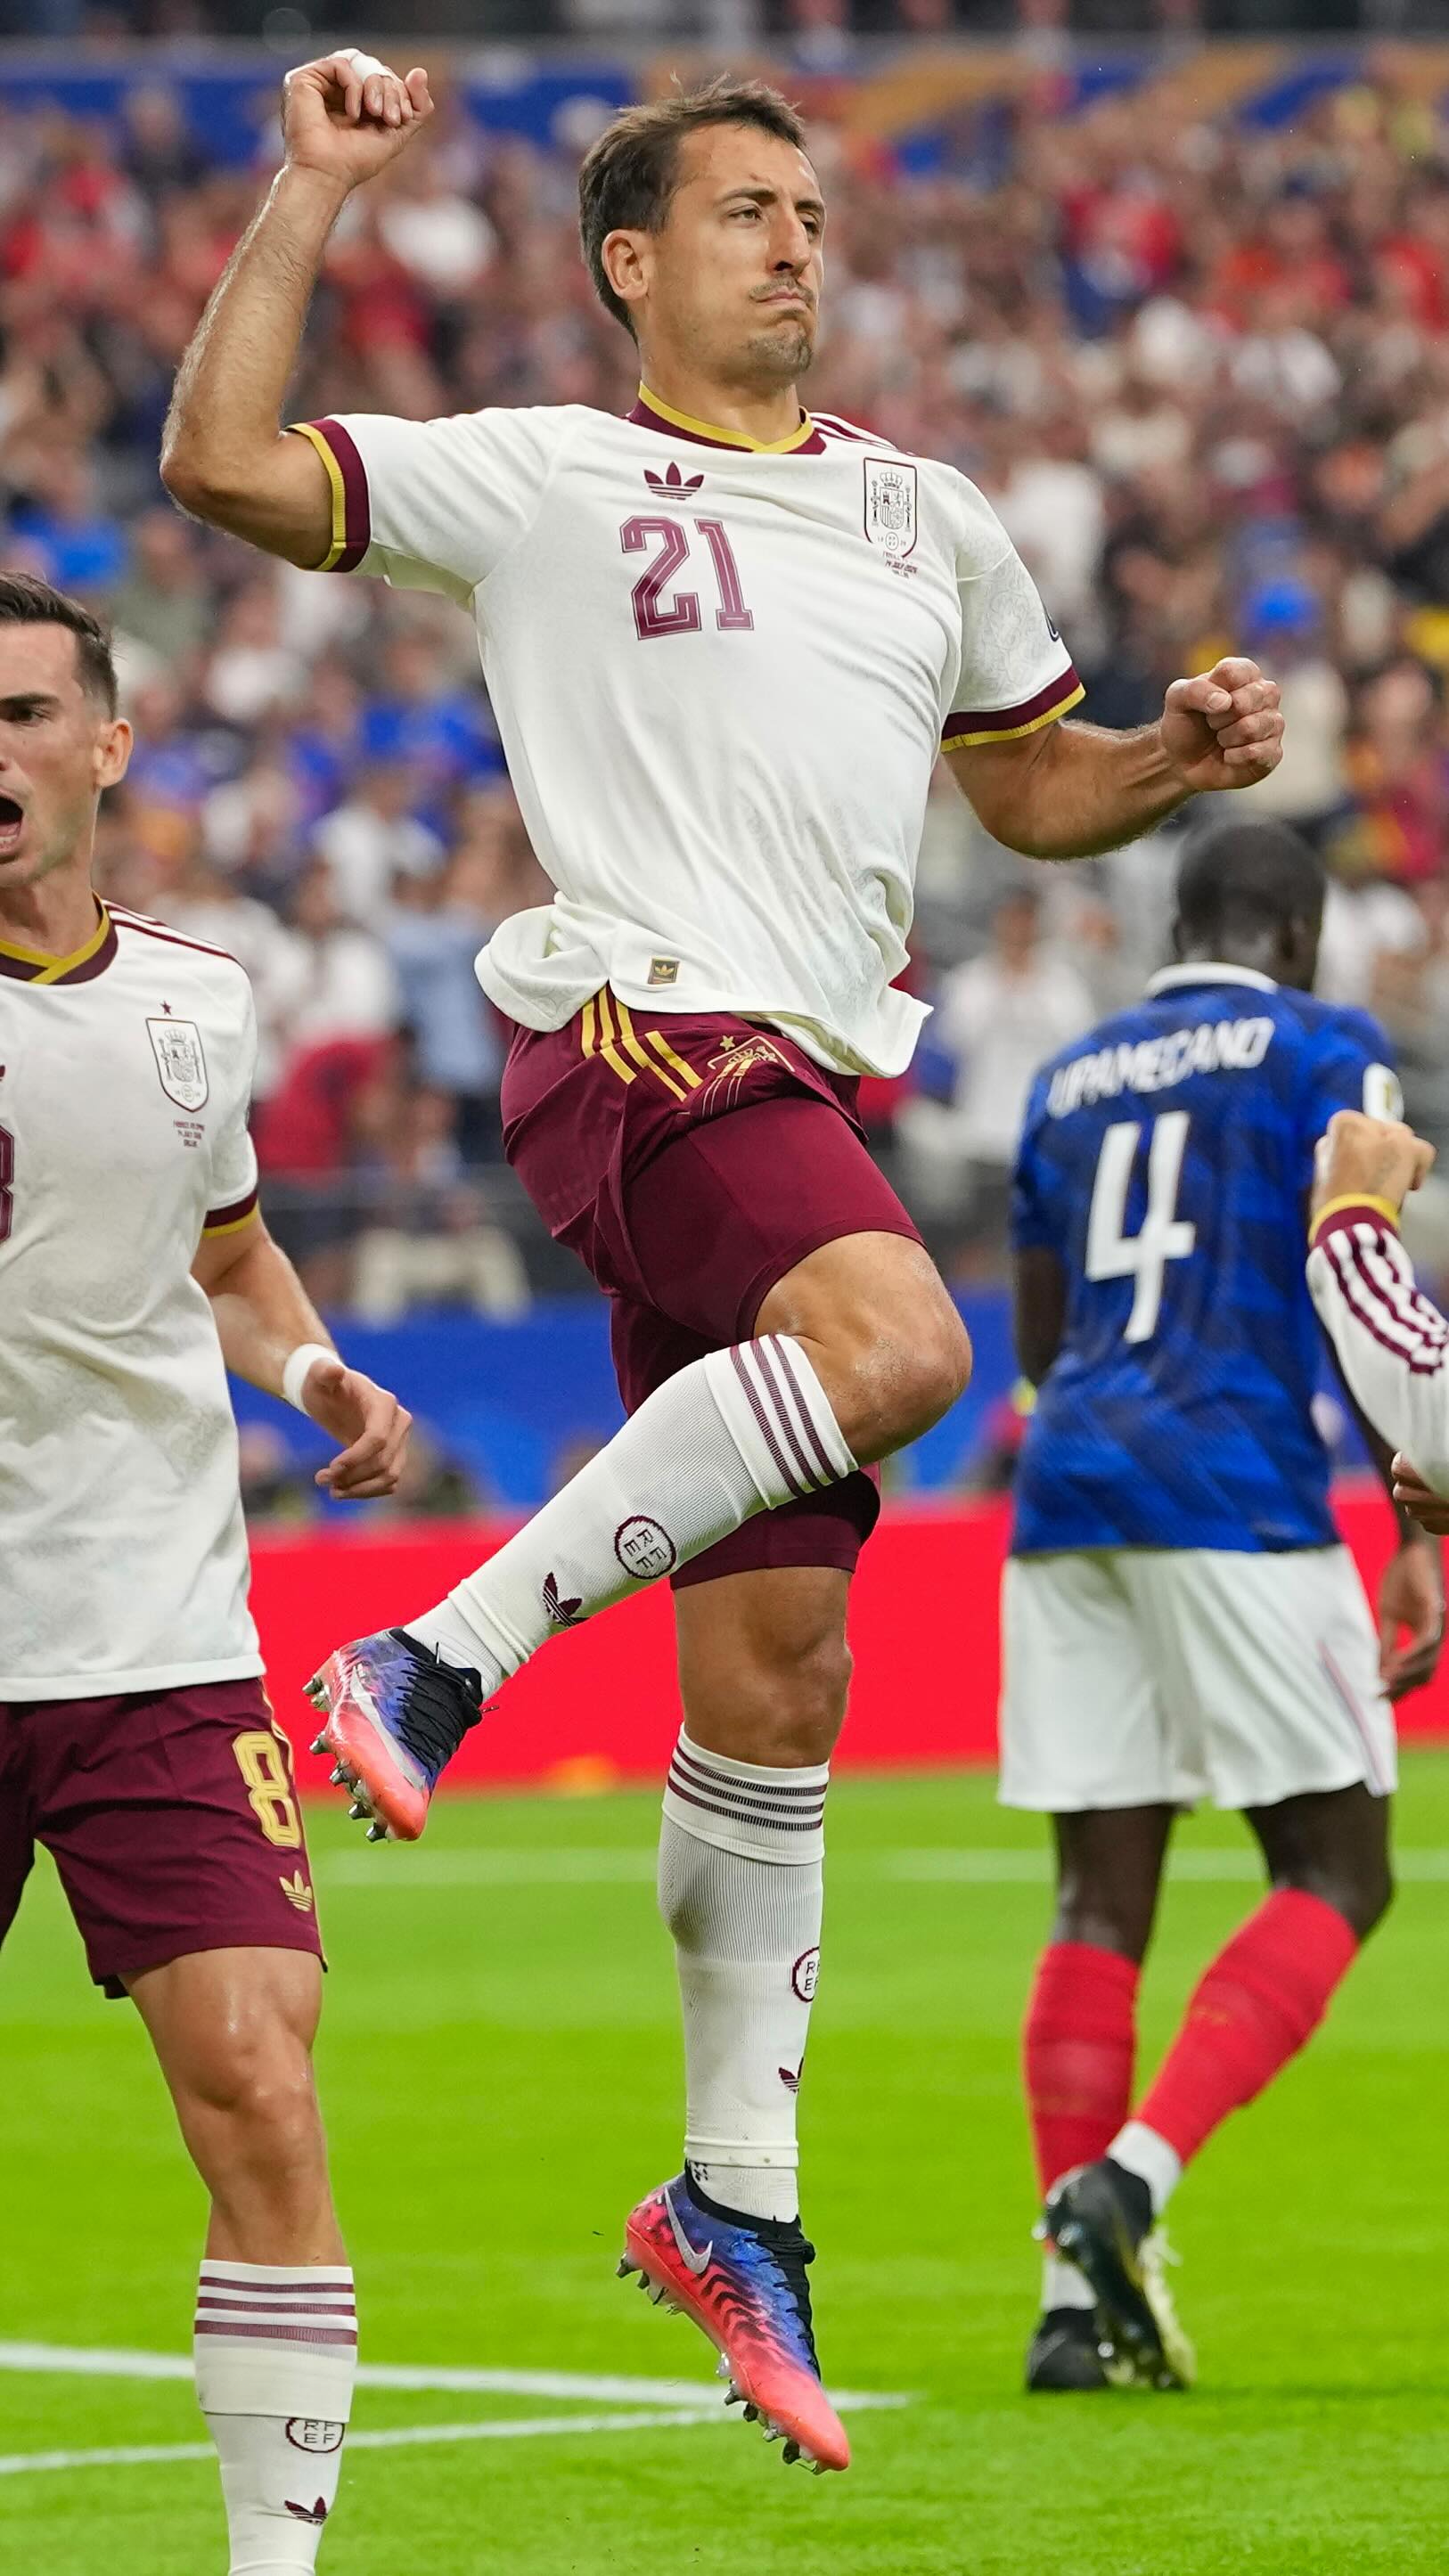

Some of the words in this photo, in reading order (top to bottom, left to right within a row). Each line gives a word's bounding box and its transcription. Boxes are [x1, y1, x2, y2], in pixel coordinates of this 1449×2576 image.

[619, 515, 754, 641] 21
[1047, 1018, 1275, 1119] UPAMECANO
[1085, 1110, 1197, 1344] 4
[232, 1730, 301, 1849] 8
[305, 2433, 335, 2444] EF
